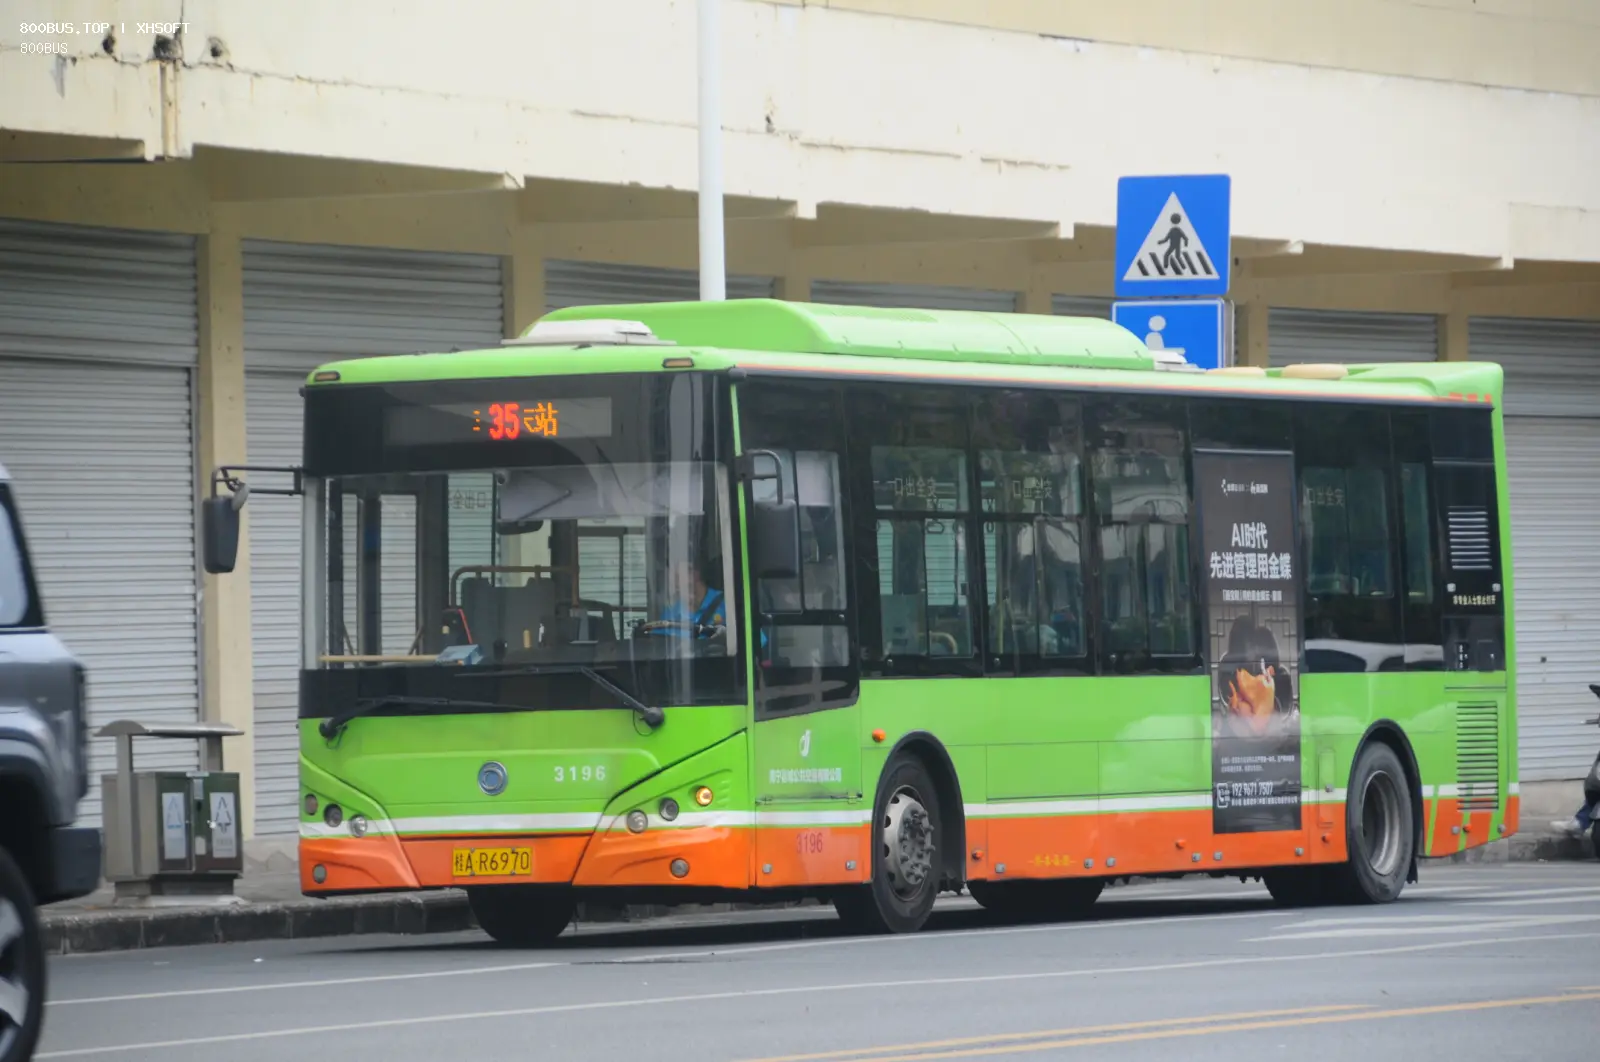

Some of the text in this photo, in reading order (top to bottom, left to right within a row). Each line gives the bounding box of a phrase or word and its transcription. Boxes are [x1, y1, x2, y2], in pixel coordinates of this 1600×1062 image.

[488, 402, 520, 440] 35
[1231, 521, 1269, 549] AI时代
[1210, 551, 1292, 580] 先进管理用金蝶
[554, 765, 606, 782] 3196
[796, 832, 823, 854] 3196
